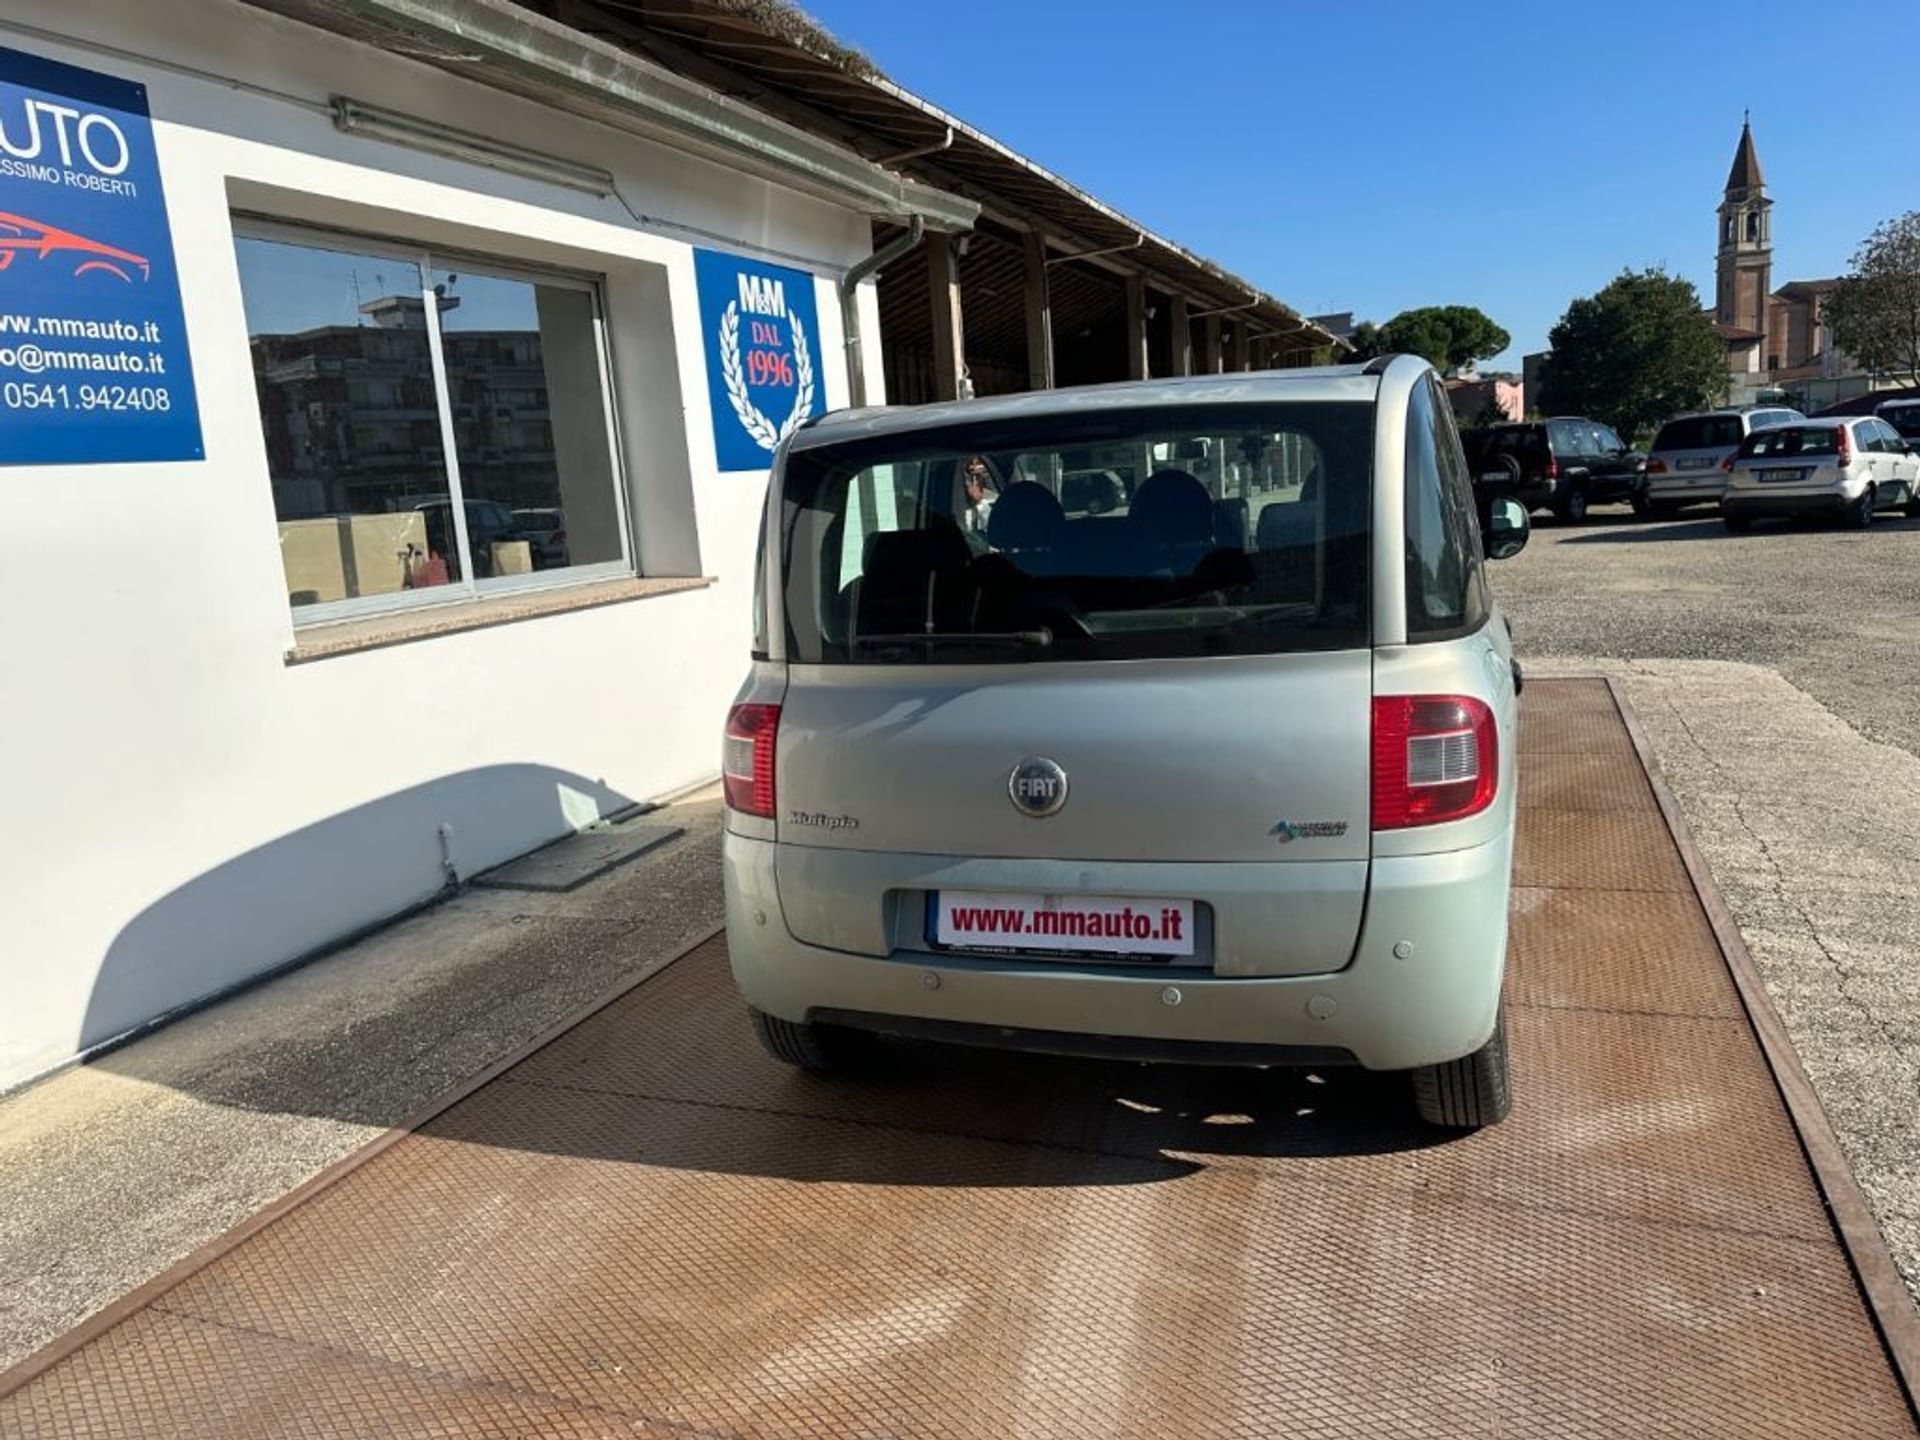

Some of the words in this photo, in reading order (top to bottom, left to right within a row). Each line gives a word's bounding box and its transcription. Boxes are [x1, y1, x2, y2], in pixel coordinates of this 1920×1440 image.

[0, 159, 60, 184] SSIMO
[63, 169, 137, 197] ROBERTI
[737, 272, 786, 318] M&M
[751, 321, 782, 347] DAL
[746, 349, 793, 388] 1996
[4, 382, 171, 411] 0541.942408
[1018, 778, 1056, 797] FIAT
[951, 907, 1183, 941] www.mmauto.it
